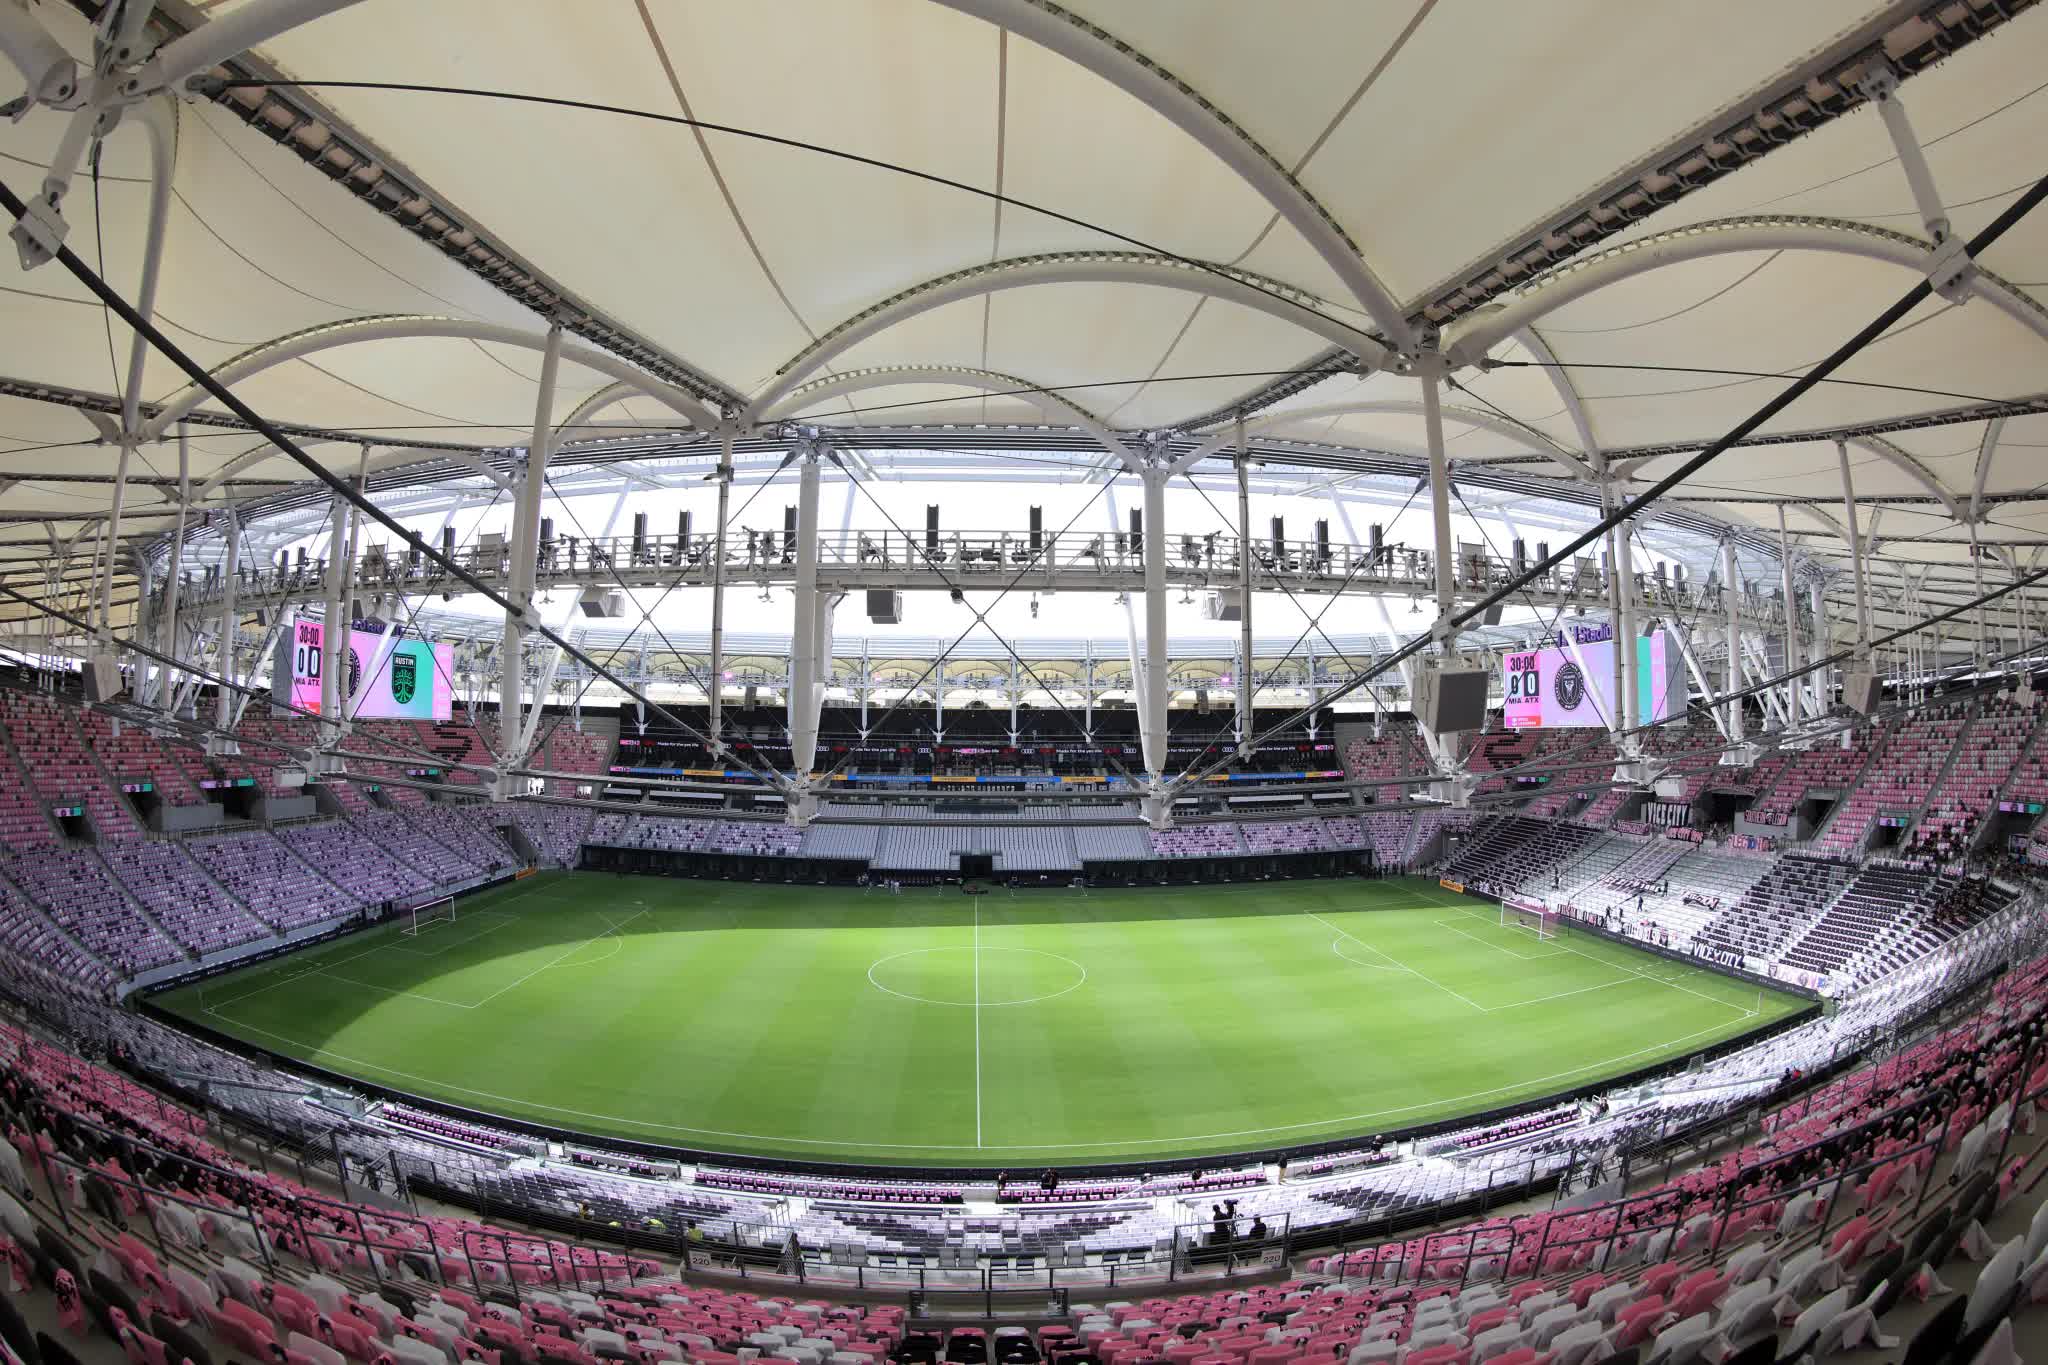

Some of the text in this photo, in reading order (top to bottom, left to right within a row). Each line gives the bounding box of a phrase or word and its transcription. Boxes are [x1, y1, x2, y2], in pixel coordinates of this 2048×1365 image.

[300, 625, 320, 645] 30:00
[298, 648, 319, 675] 0 0
[395, 656, 414, 666] AUSTIN
[1510, 655, 1535, 671] 30:00
[295, 677, 306, 685] MIA
[1511, 673, 1536, 694] 0 0
[1647, 802, 1688, 826] VICE CITY
[1692, 941, 1715, 962] VICE
[1720, 952, 1742, 969] CITY
[692, 1257, 710, 1266] 220
[1263, 1255, 1281, 1263] 220
